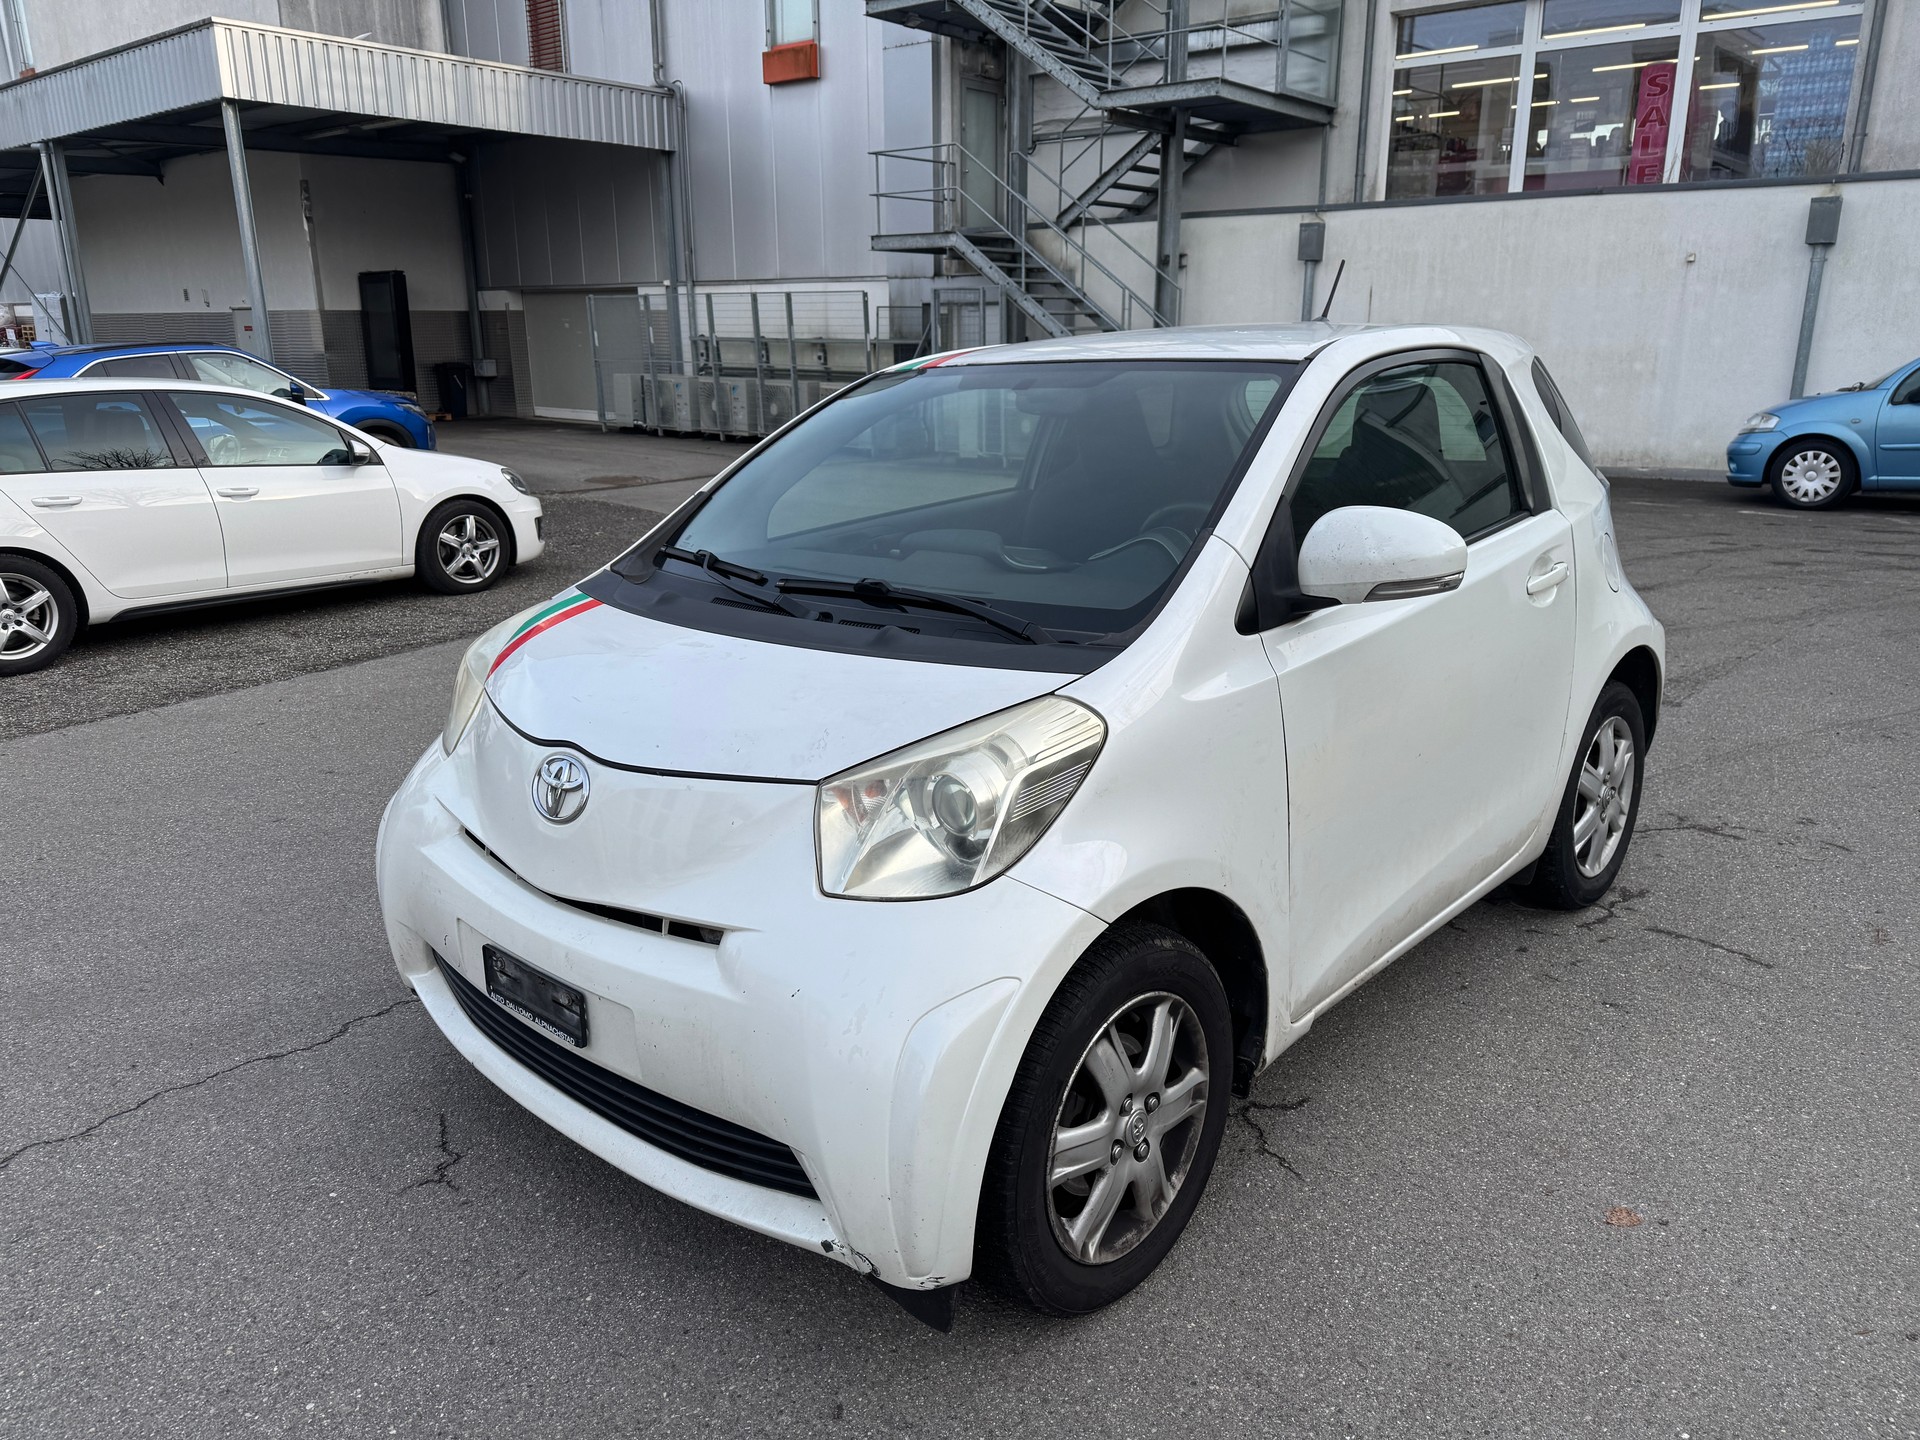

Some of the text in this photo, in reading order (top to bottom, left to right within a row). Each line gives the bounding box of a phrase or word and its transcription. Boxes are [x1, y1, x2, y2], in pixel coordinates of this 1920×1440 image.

[1636, 72, 1670, 184] SALE
[490, 991, 505, 1005] AUTO
[535, 1017, 575, 1045] ALPNACHSTAD
